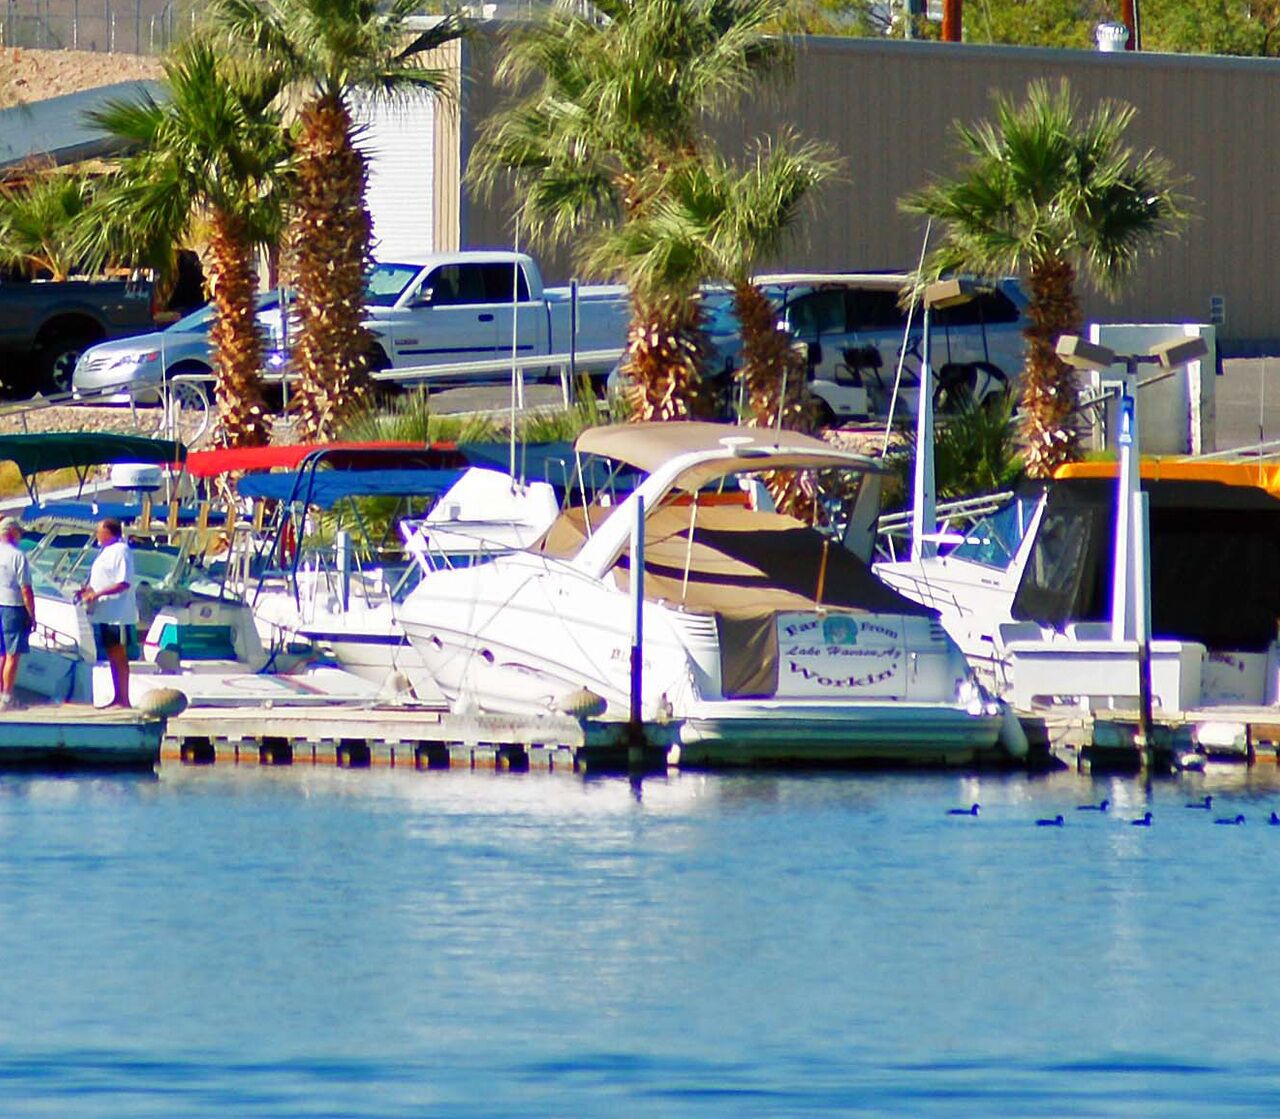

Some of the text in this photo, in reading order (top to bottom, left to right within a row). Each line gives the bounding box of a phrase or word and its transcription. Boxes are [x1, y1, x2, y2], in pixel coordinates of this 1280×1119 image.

[785, 620, 898, 639] Far From
[786, 645, 821, 656] Lake
[789, 660, 897, 687] Workin'
